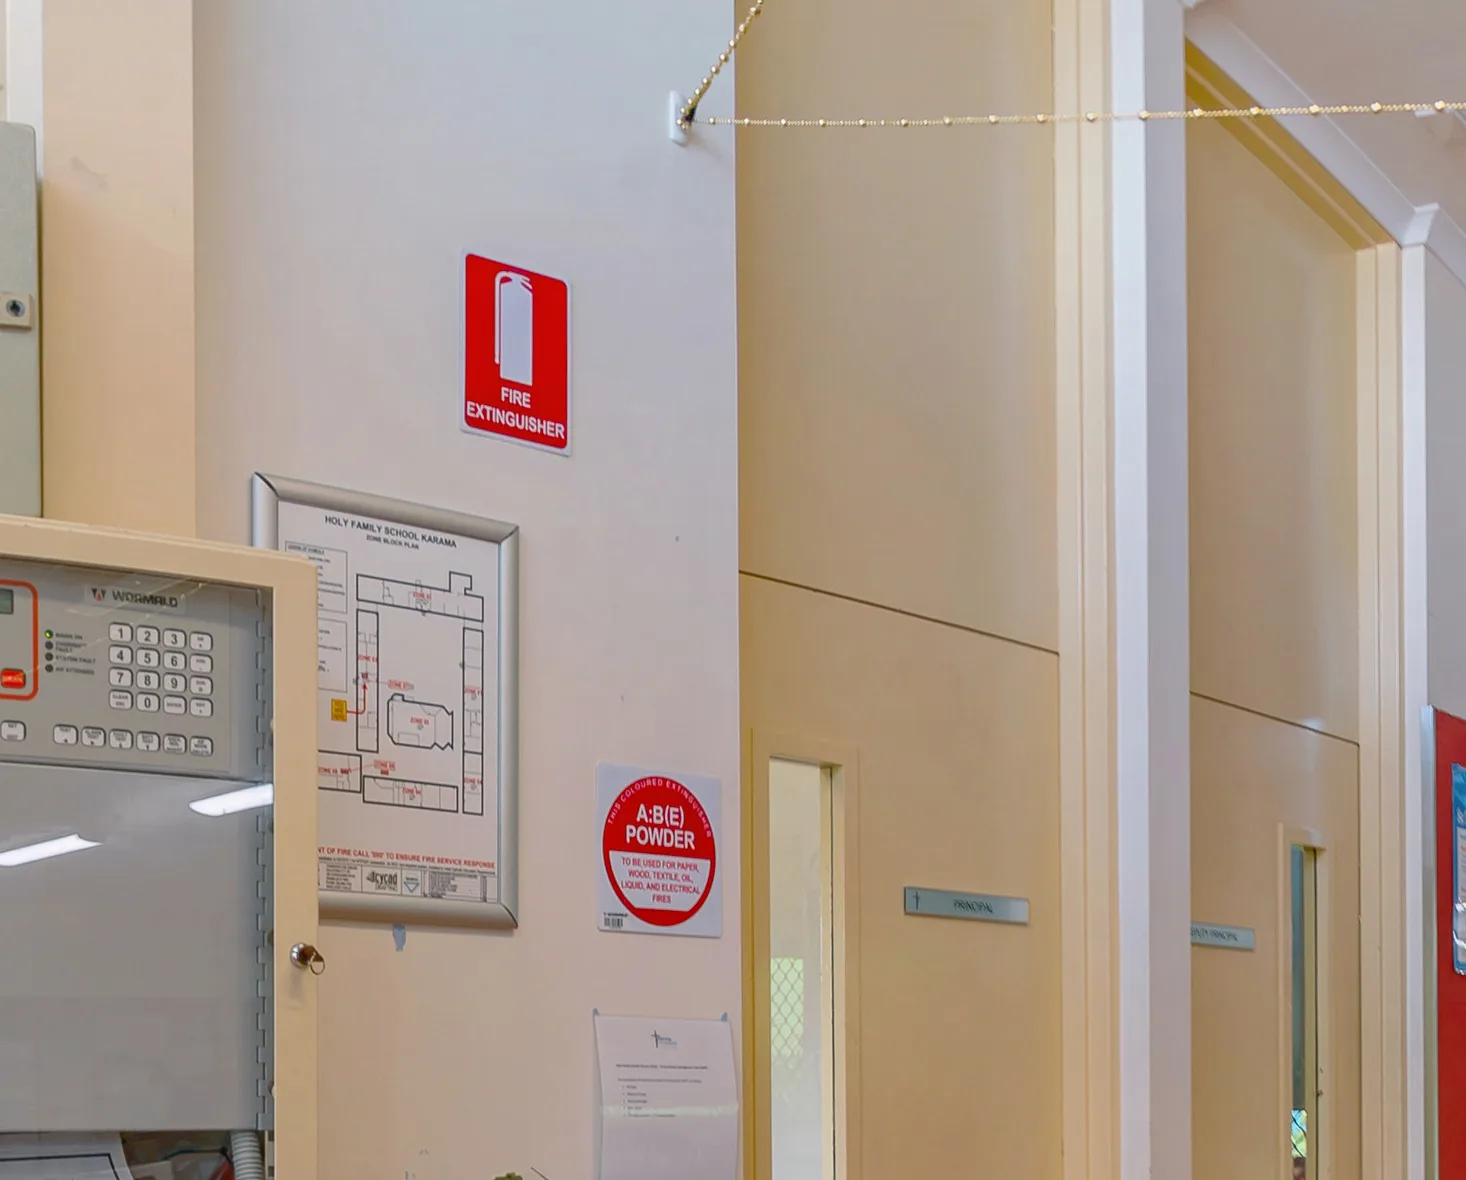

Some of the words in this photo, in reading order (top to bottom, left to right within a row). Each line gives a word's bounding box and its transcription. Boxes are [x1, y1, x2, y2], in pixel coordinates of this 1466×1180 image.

[501, 386, 531, 408] FIRE
[466, 400, 565, 440] EXTINGUISHER
[325, 515, 349, 527] HOLY
[351, 520, 381, 534] FAMILY
[385, 526, 420, 541] SCHOOL
[421, 533, 457, 548] KARAMA
[404, 541, 419, 550] PLAN
[112, 590, 178, 607] WORMALD
[118, 628, 124, 639] 1
[144, 630, 151, 642] 2
[171, 633, 178, 644] 3
[117, 650, 124, 661] 4
[144, 653, 151, 664] 5
[171, 656, 178, 667] 6
[117, 673, 124, 683] 7
[144, 675, 151, 686] 8
[171, 678, 178, 689] 9
[144, 698, 151, 709] 0
[608, 803, 620, 824] THIS
[620, 778, 662, 802] COLOURED
[666, 780, 711, 838] EXTINGUISHER
[637, 803, 684, 828] A:B(E)
[626, 824, 695, 850] POWDER
[337, 848, 351, 856] FIRE
[353, 849, 369, 858] CALL
[386, 852, 395, 860] TO
[396, 853, 421, 862] ENSURE
[422, 855, 435, 864] FIRE
[437, 857, 462, 866] SERVICE
[464, 859, 495, 869] RESPONSE
[622, 857, 631, 865] TO
[632, 858, 641, 867] BE
[643, 859, 660, 868] USED
[662, 861, 676, 869] FOR
[677, 862, 700, 873] PAPER,
[628, 870, 651, 880] WOOD,
[646, 883, 660, 891] AND
[661, 884, 700, 894] ELECTRICAL
[652, 894, 671, 904] FIRES
[953, 899, 993, 914] PRINCIPAL
